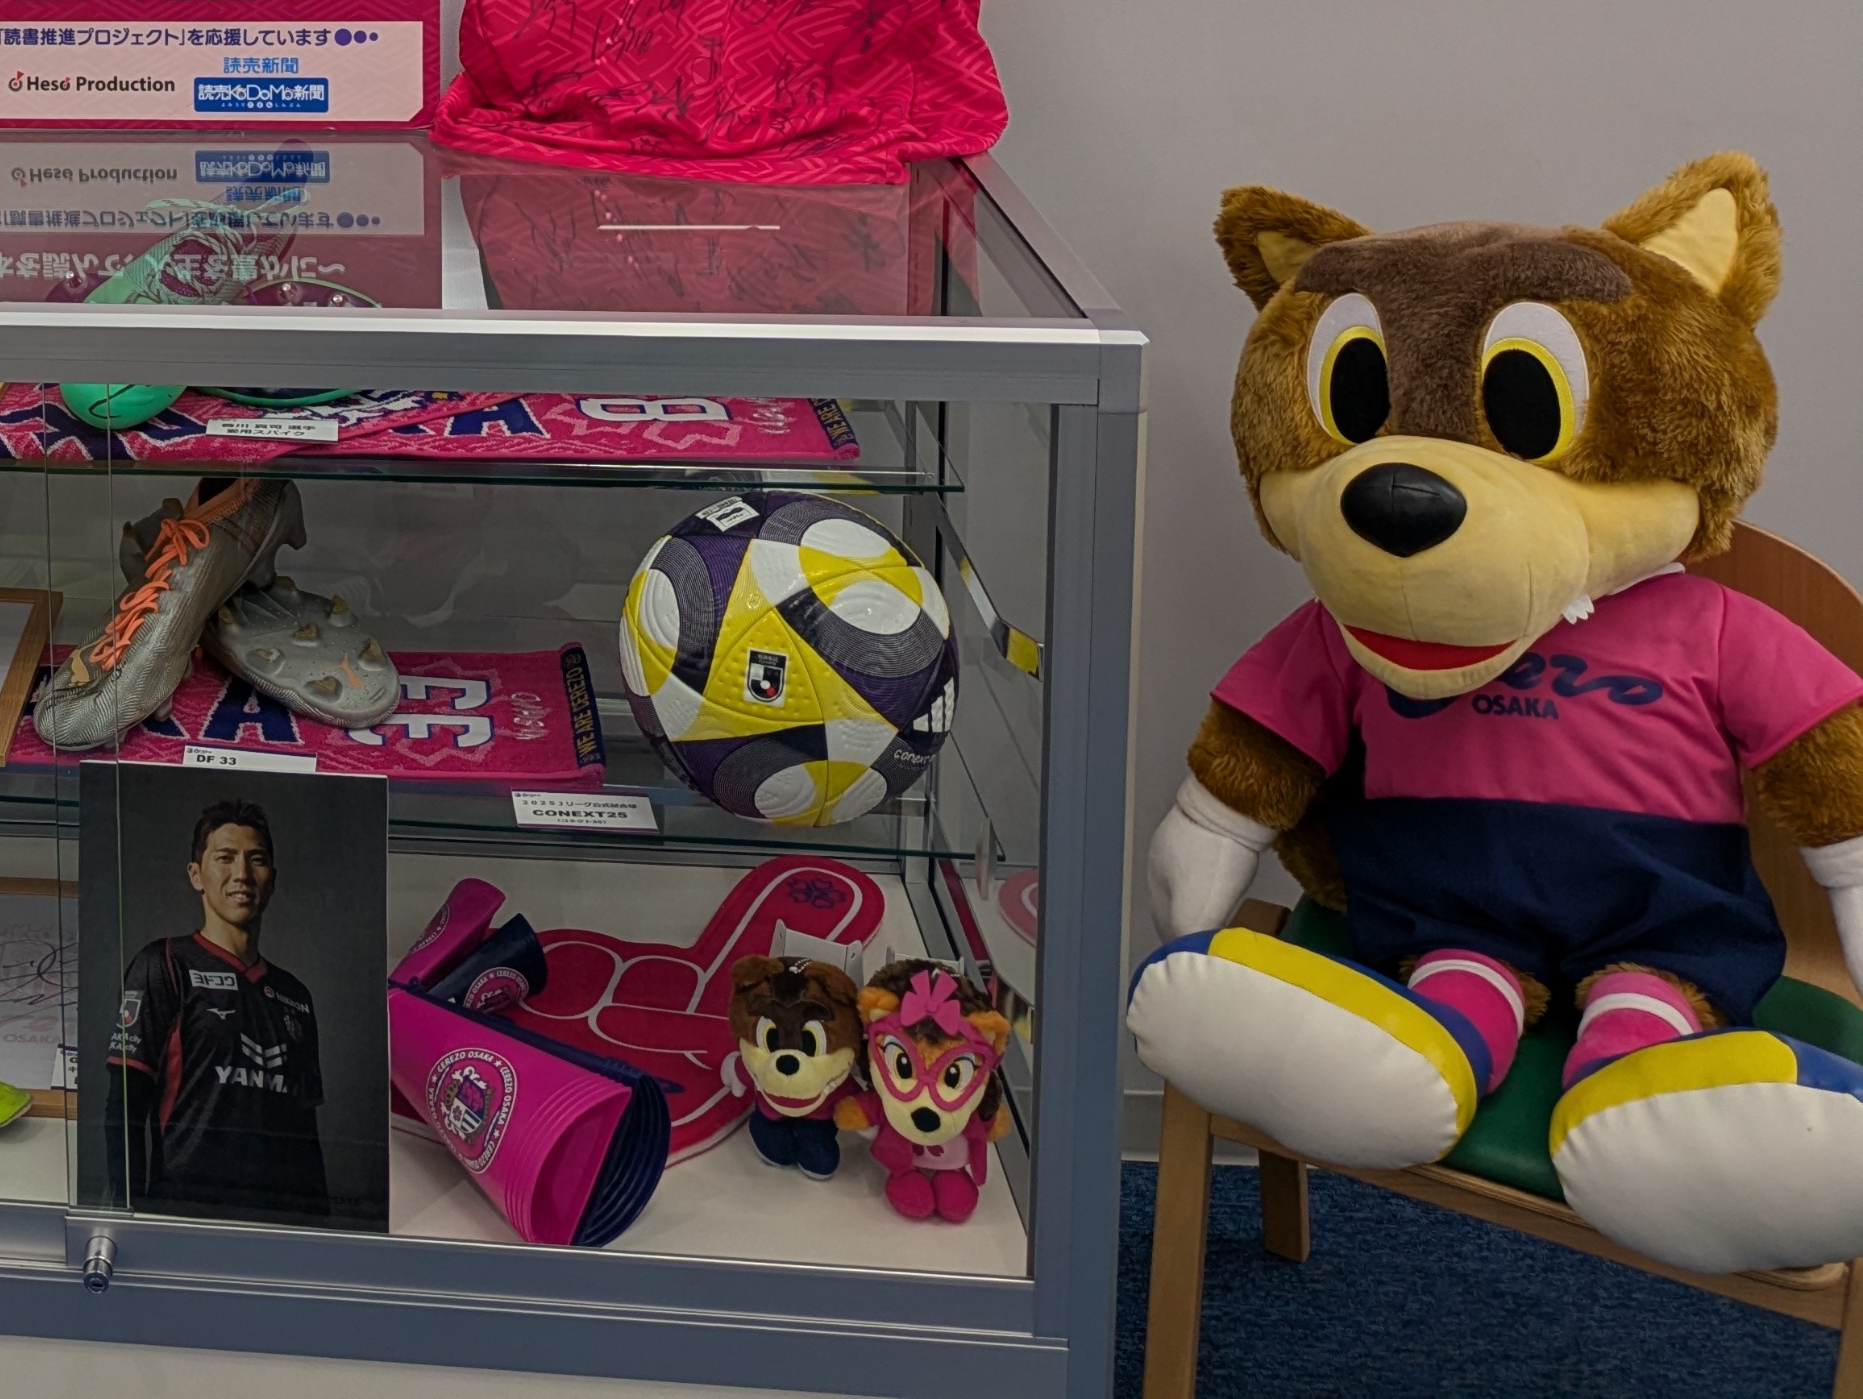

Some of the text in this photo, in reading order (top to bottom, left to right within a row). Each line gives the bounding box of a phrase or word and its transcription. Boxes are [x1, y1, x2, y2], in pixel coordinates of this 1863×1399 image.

[222, 56, 300, 74] 読売新聞
[75, 75, 176, 93] Production
[1471, 693, 1559, 721] OSAKA
[573, 709, 595, 735] ARE
[576, 732, 598, 758] WE
[196, 754, 237, 766] DF 33
[532, 809, 628, 819] CONEXT25
[436, 1051, 466, 1073] CEREZO
[467, 1050, 495, 1063] OSAKA
[497, 1095, 512, 1126] OSAKA
